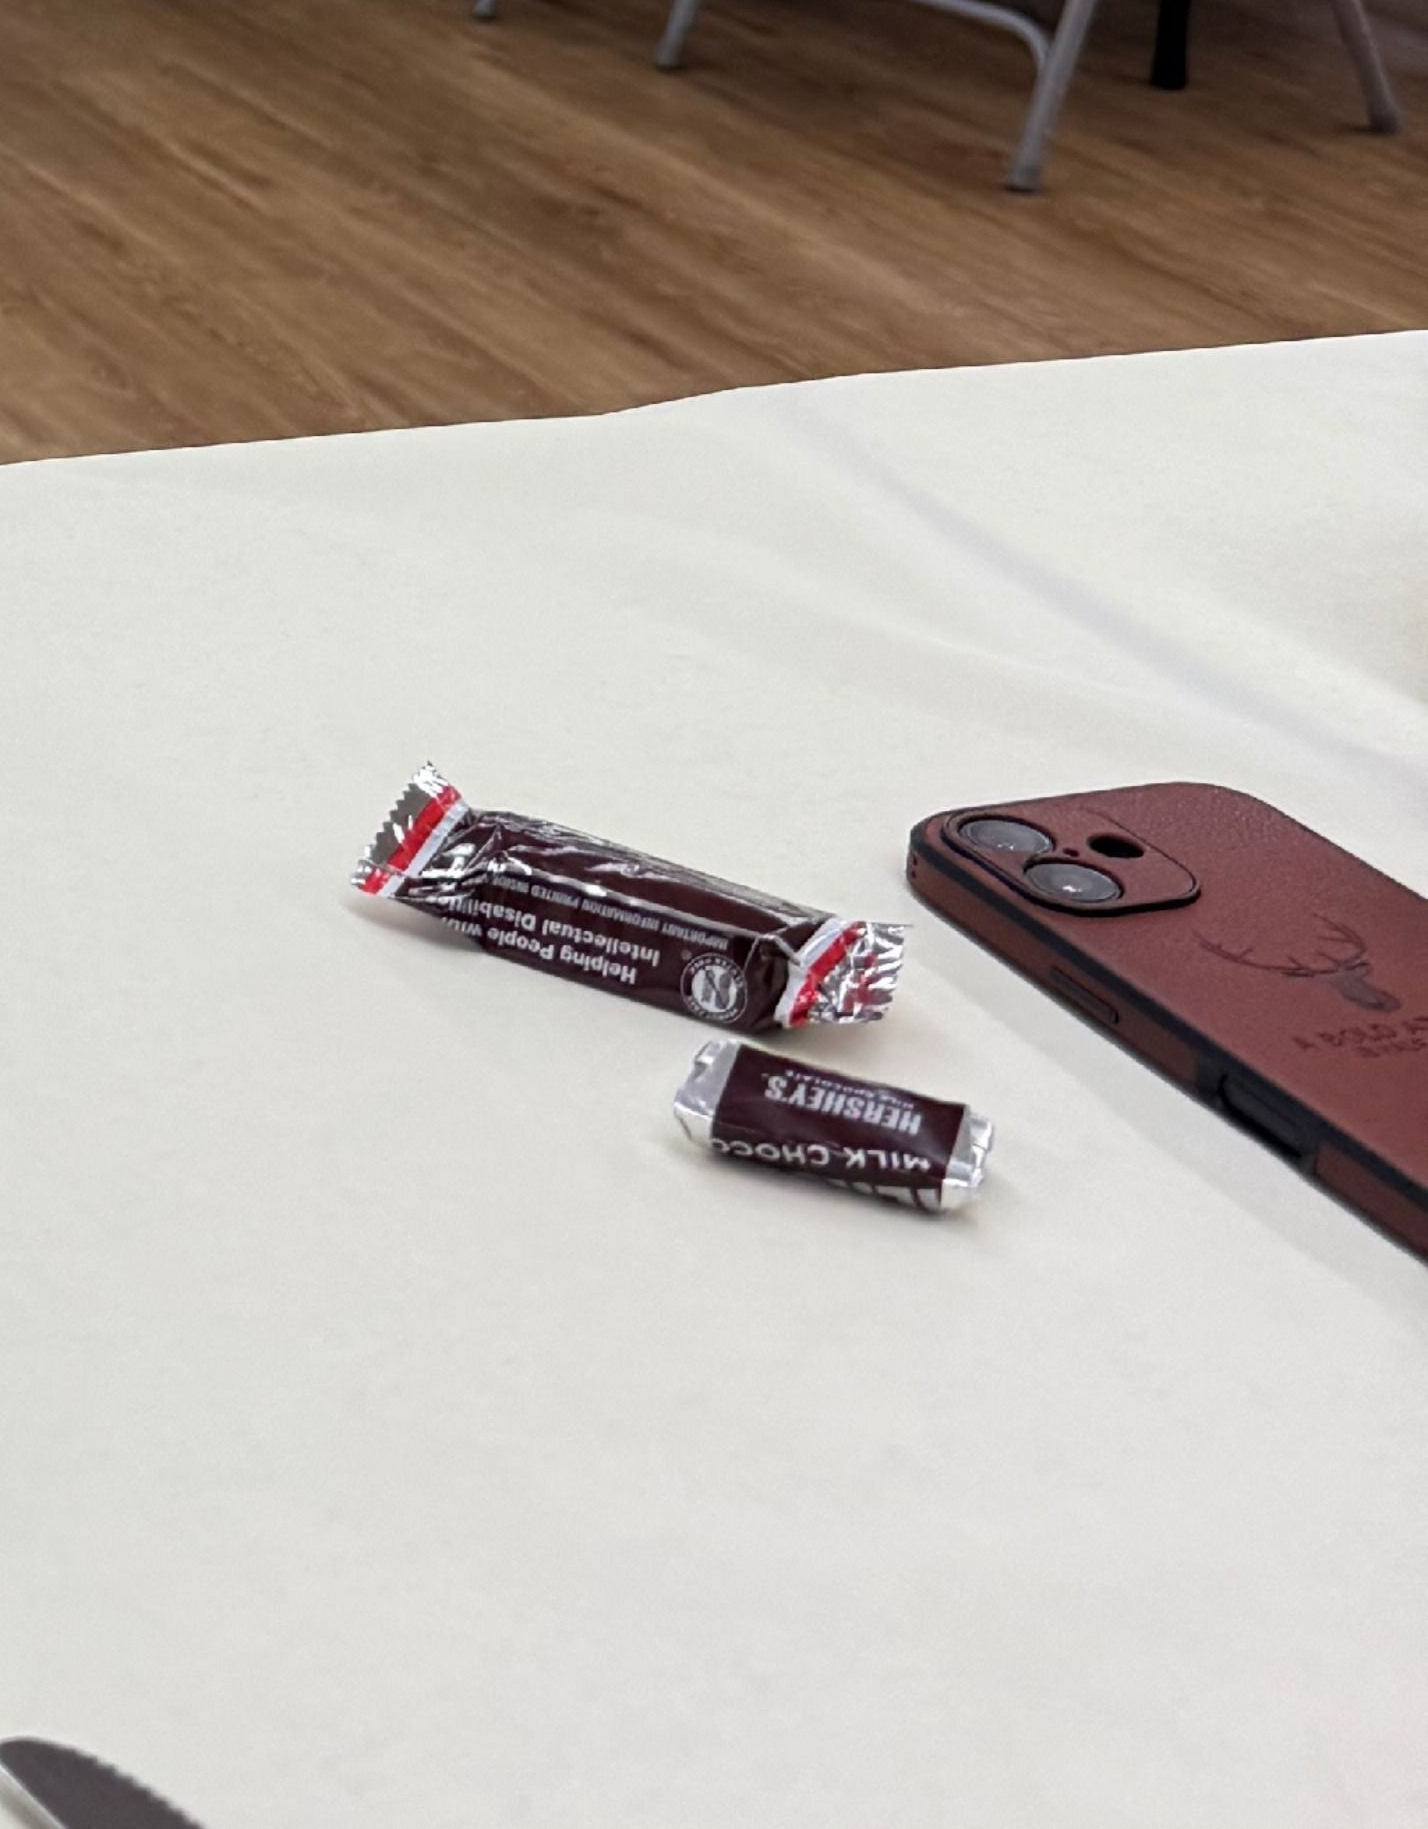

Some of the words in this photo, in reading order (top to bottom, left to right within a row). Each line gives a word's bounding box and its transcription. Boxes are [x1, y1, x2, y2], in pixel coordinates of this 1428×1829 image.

[581, 898, 660, 931] INFORMATION
[487, 928, 554, 961] People
[542, 919, 660, 967] Intellectual
[661, 921, 729, 951] IMPORTANT
[560, 943, 637, 985] Helping
[765, 1074, 922, 1136] HERSHEY'S
[844, 1146, 930, 1172] MILK
